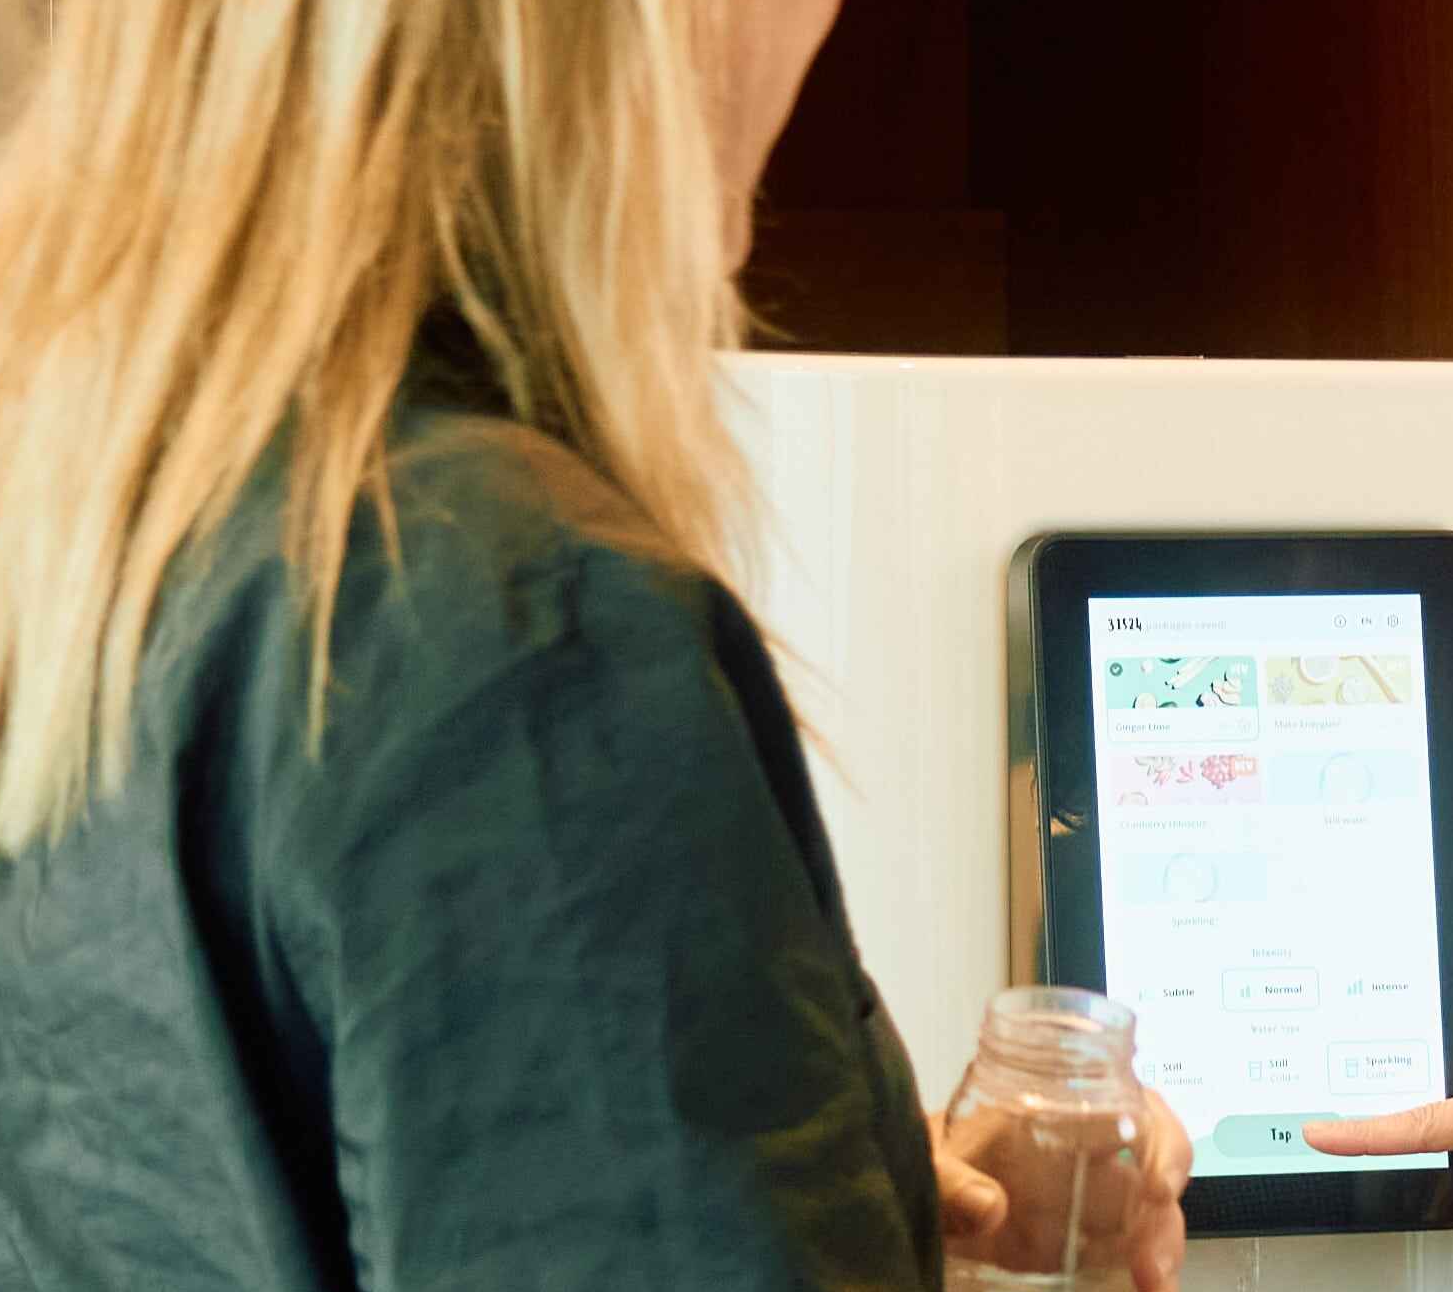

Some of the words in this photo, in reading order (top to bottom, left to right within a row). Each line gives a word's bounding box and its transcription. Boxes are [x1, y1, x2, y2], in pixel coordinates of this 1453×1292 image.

[1163, 988, 1195, 998] Subtle
[1265, 984, 1303, 995] Normal
[1371, 982, 1409, 992] Intense
[1268, 1057, 1289, 1070] Still
[1365, 1054, 1412, 1067] Sparkling
[1270, 1126, 1292, 1144] Tap
